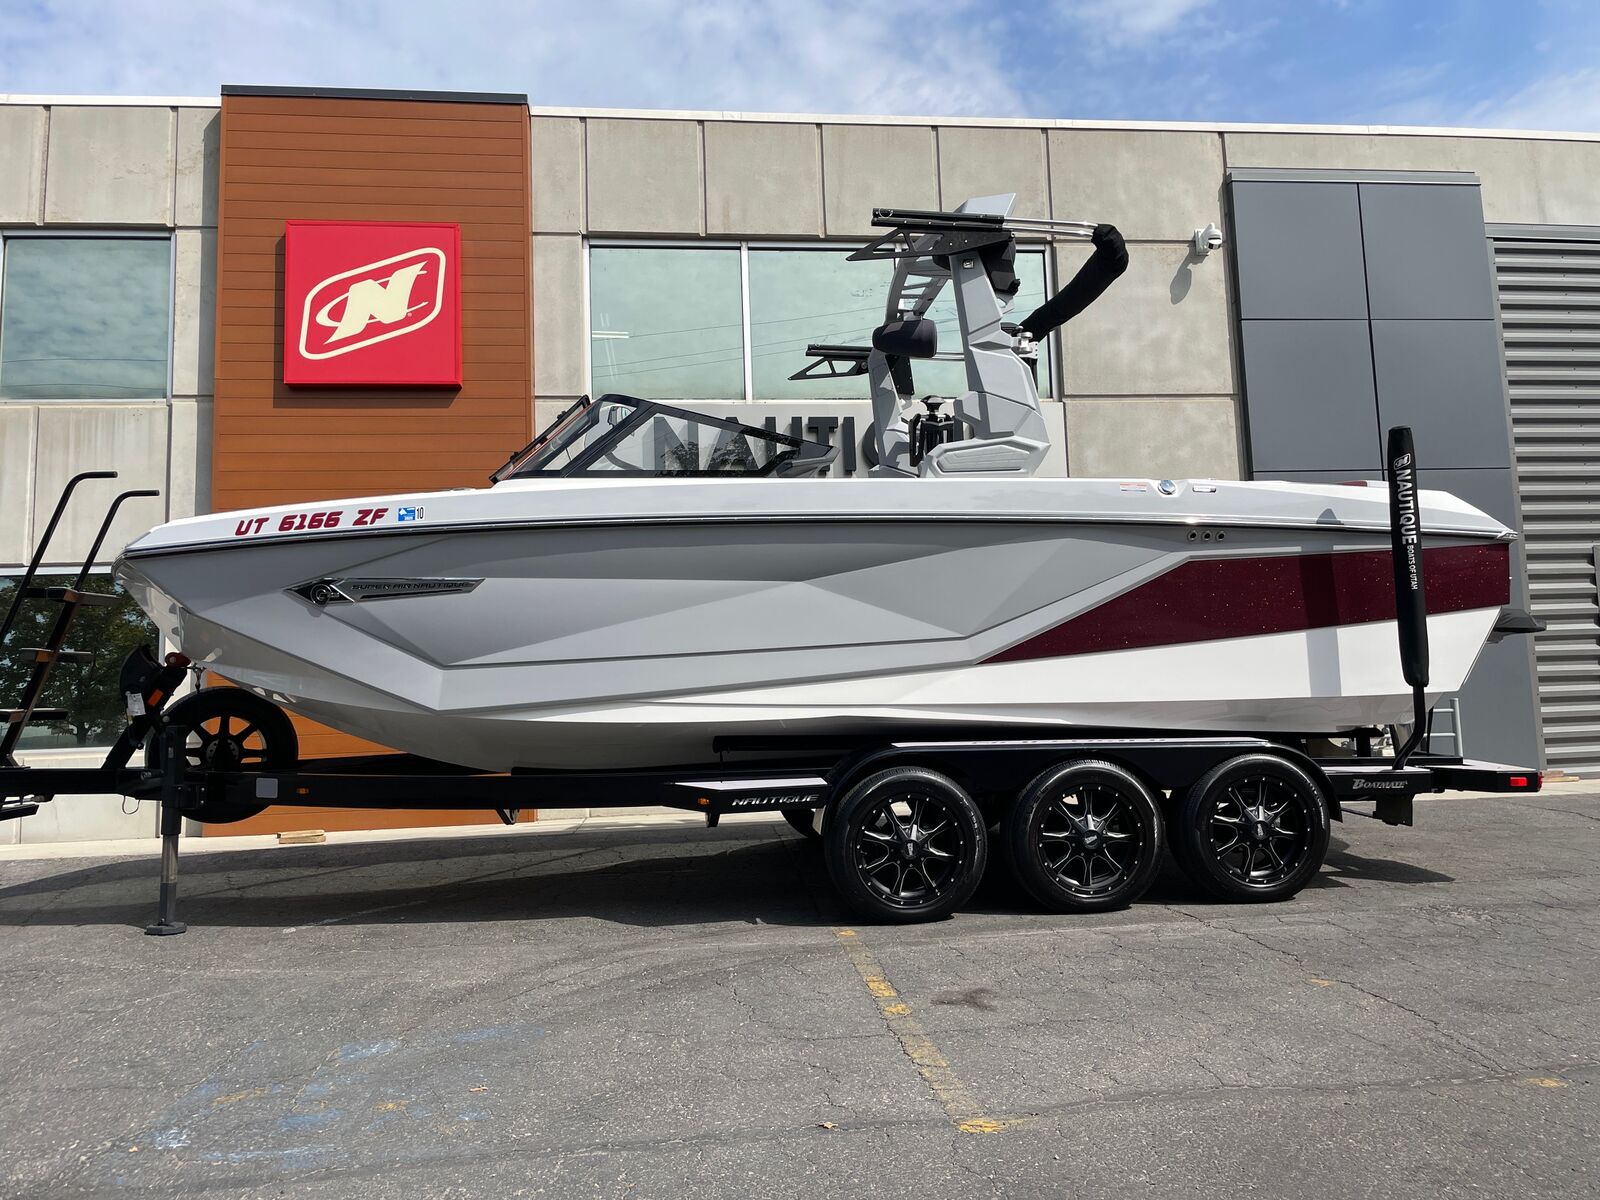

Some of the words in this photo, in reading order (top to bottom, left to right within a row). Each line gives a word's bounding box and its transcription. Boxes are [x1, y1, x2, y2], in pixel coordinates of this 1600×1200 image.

[654, 416, 964, 472] NAUTI
[416, 507, 424, 519] 10
[1396, 469, 1417, 545] NAUTIQUE
[235, 517, 270, 536] UT
[278, 511, 344, 532] 6166
[352, 508, 389, 526] ZF
[1407, 545, 1415, 564] BOATS
[1409, 565, 1416, 573] OF
[1410, 574, 1418, 590] UTAH
[732, 794, 820, 806] NAUTIQUE
